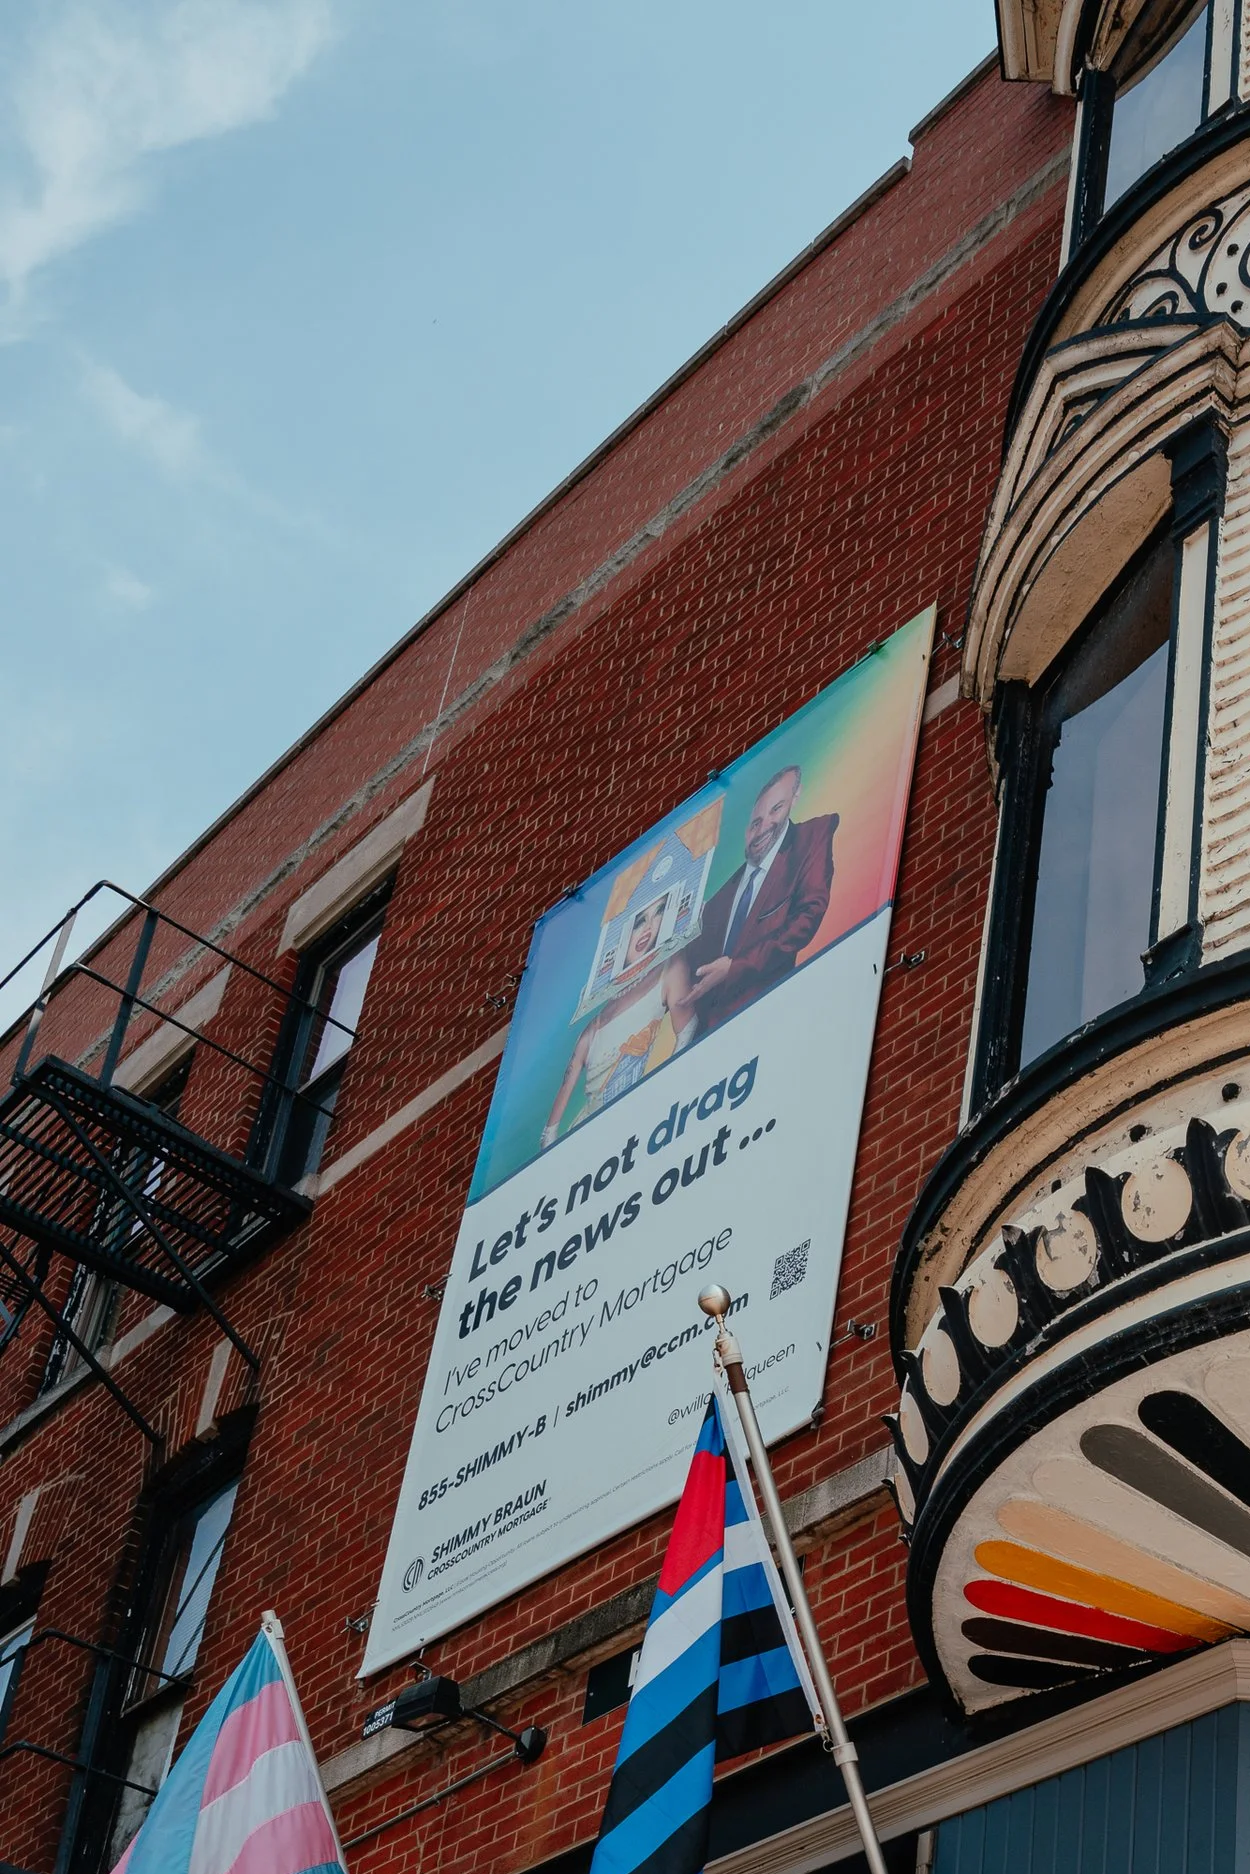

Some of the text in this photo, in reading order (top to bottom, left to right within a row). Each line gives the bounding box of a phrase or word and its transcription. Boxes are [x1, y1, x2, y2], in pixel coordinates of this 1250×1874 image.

[468, 1055, 759, 1283] Let's not drag
[436, 1227, 733, 1433] CrossCountry Mortgage
[458, 1274, 522, 1339] the
[529, 1191, 643, 1293] news
[418, 1292, 749, 1510] 855-SHIMMY-B shimmy@ccm.cm
[444, 1278, 599, 1396] I've moved to
[427, 1532, 497, 1581] CROSSCOUNTRY
[431, 1480, 547, 1564] SHIMMY BRAUN
[374, 1700, 396, 1719] PERMIT
